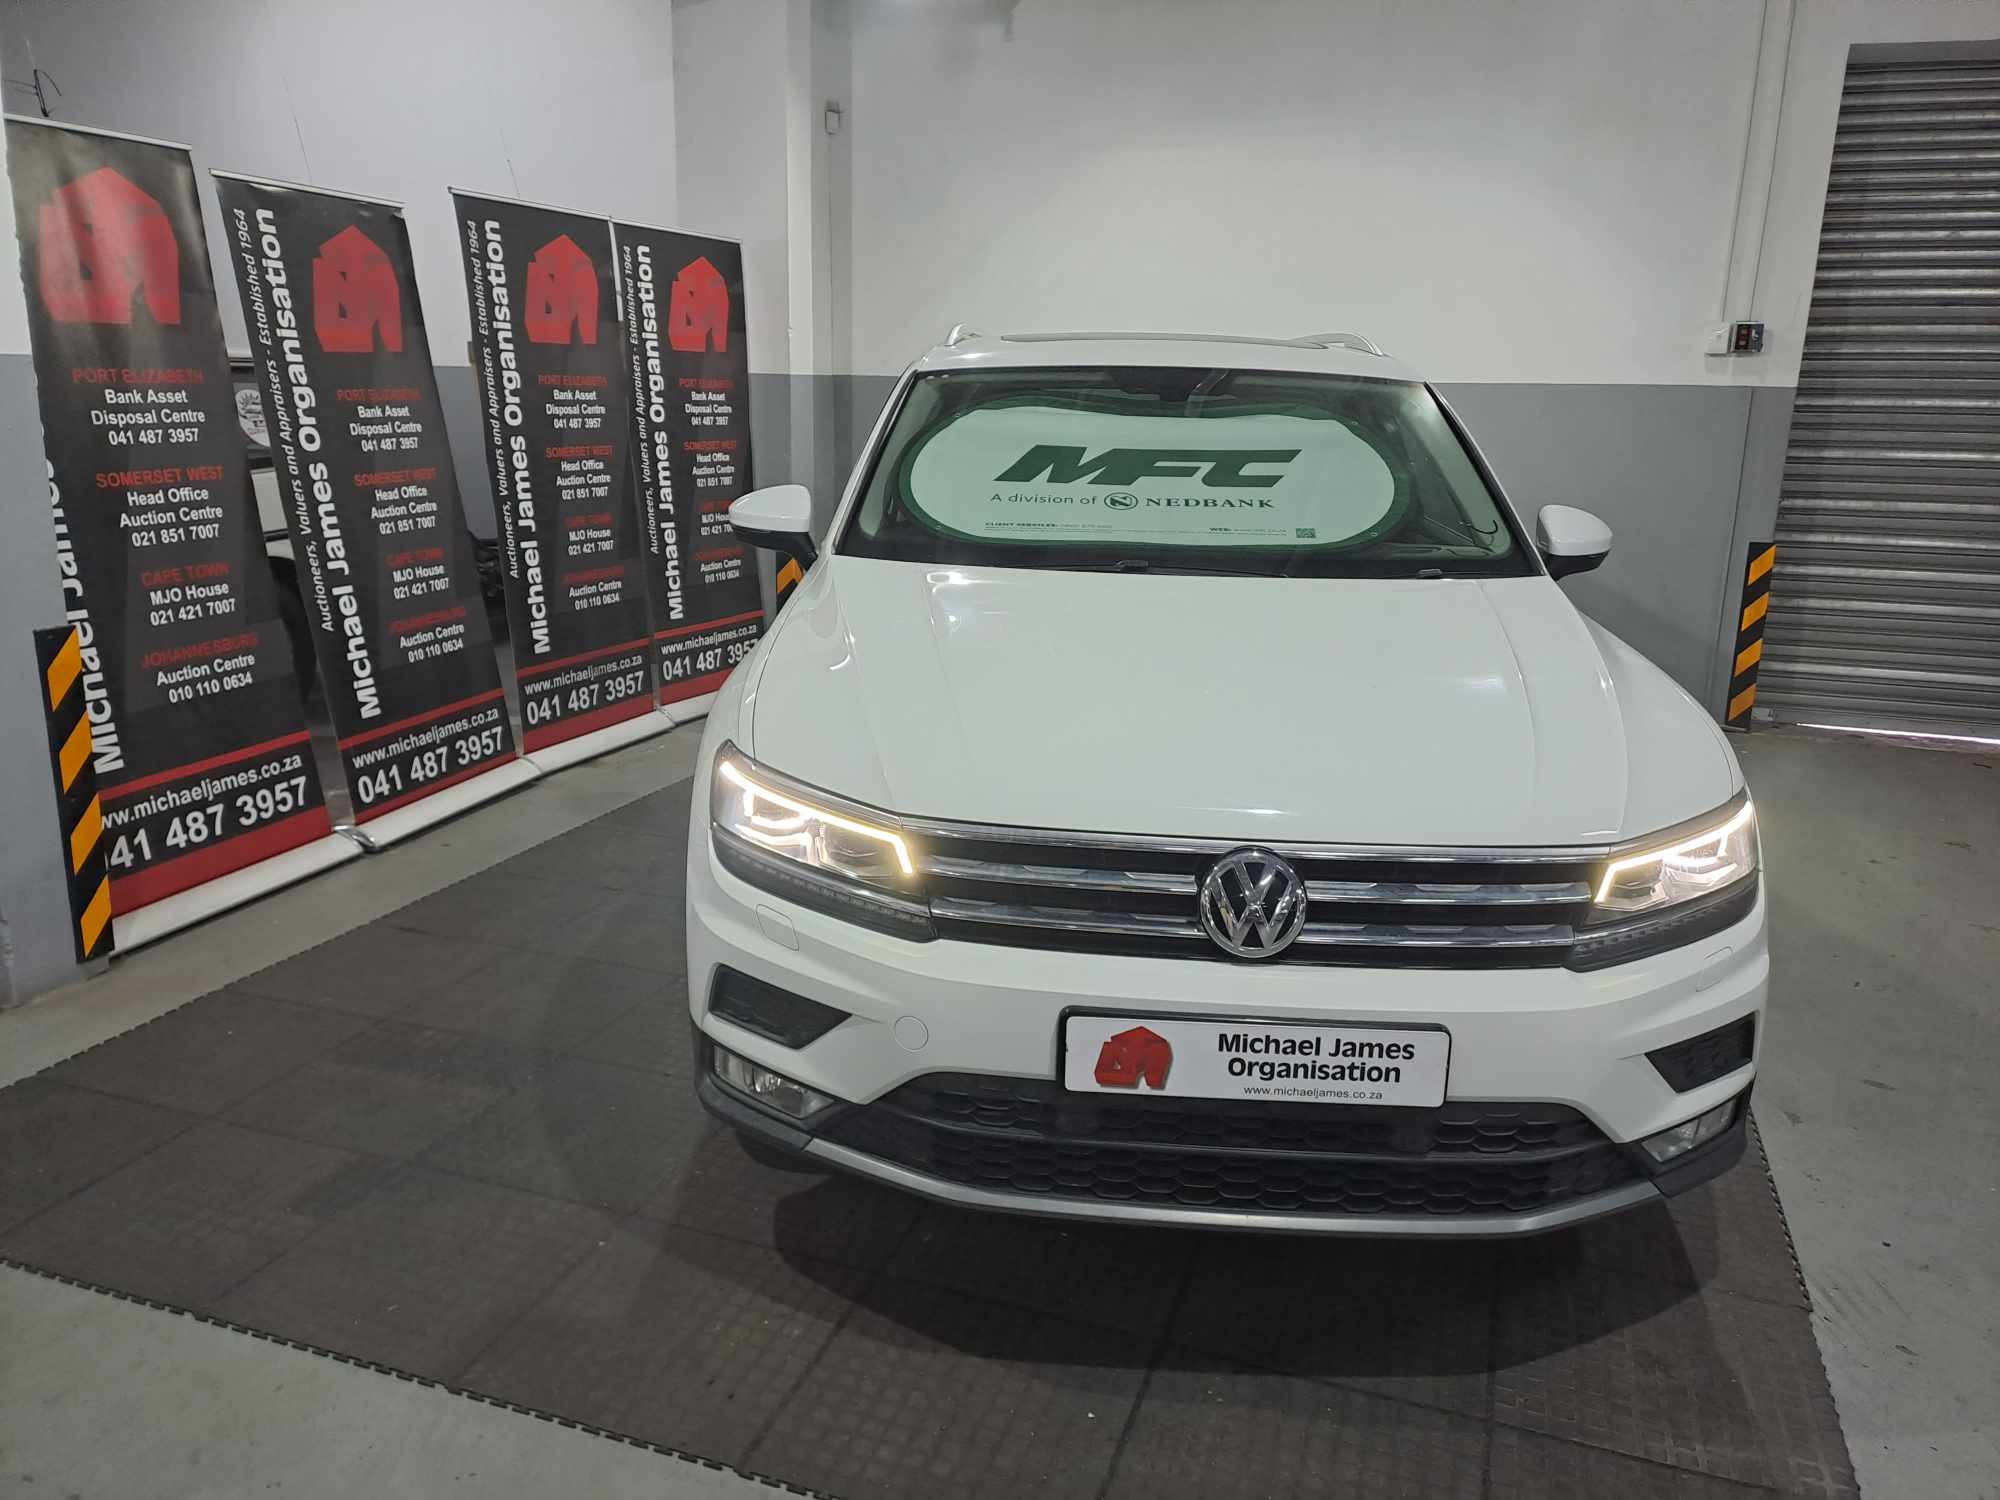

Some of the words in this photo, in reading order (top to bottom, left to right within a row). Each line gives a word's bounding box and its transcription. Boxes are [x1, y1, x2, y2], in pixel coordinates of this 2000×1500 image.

[233, 207, 252, 249] 1964
[467, 220, 480, 254] 1964
[241, 252, 272, 346] Established
[470, 256, 489, 335] Established
[255, 208, 321, 452] Organisation
[484, 219, 523, 427] Organisation
[637, 245, 665, 423] Organisation
[482, 346, 501, 417] Appraisers
[553, 389, 573, 400] Bank
[575, 389, 597, 401] Asset
[632, 354, 646, 415] Appraisers
[104, 388, 144, 404] Bank
[146, 388, 189, 404] Asset
[266, 359, 293, 442] Appraisers
[545, 403, 580, 416] Disposal
[581, 404, 606, 415] Centre
[90, 409, 158, 427] Disposal
[160, 408, 206, 423] Centre
[357, 405, 383, 418] Bank
[384, 404, 410, 417] Asset
[553, 418, 567, 429] 041
[108, 429, 134, 446] 041
[138, 429, 163, 444] 487
[167, 427, 199, 443] 3957
[349, 421, 393, 437] Disposal
[394, 421, 422, 433] Centre
[490, 419, 502, 445] and
[635, 416, 648, 439] and
[361, 439, 378, 452] 041
[380, 438, 397, 451] 487
[399, 436, 418, 450] 3957
[281, 444, 299, 475] and
[495, 448, 509, 496] Valuers
[560, 461, 580, 472] Head
[581, 459, 604, 471] Office
[640, 441, 651, 483] Valuers
[654, 430, 674, 515] James
[992, 444, 1303, 488] MFC
[96, 467, 181, 488] SOMERSET
[186, 465, 224, 481] WEST
[510, 435, 536, 533] James
[556, 475, 586, 487] Auction
[586, 473, 611, 484] Centre
[127, 489, 165, 507] Head
[167, 486, 209, 503] Office
[291, 478, 312, 535] Valuers
[374, 487, 400, 502] Head
[400, 485, 428, 499] Office
[561, 488, 575, 500] 021
[576, 487, 590, 499] 851
[990, 493, 1002, 502] A
[1008, 493, 1074, 505] division
[1079, 495, 1098, 505] of
[1145, 497, 1275, 509] NEDBANK
[119, 509, 176, 528] Auction
[178, 504, 224, 522] Centre
[308, 462, 350, 576] James
[370, 504, 408, 519] Auction
[408, 501, 438, 514] Centre
[131, 531, 157, 547] 021
[160, 527, 186, 544] 851
[188, 523, 220, 540] 7007
[379, 521, 396, 535] 021
[397, 518, 415, 533] 851
[415, 515, 436, 529] 7007
[568, 529, 586, 541] MJO
[586, 528, 611, 540] House
[502, 500, 519, 579] Auctioneers,
[392, 567, 414, 583] MJO
[415, 564, 445, 579] House
[660, 521, 684, 620] Michael
[150, 587, 182, 606] MJO
[185, 583, 229, 600] House
[305, 540, 335, 632] Auctioneers,
[393, 585, 410, 600] 021
[411, 581, 428, 596] 421
[429, 576, 450, 592] 7007
[520, 540, 551, 654] Michael
[569, 584, 597, 598] Auction
[150, 608, 175, 626] 021
[178, 603, 203, 621] 421
[206, 598, 236, 616] 7007
[574, 598, 588, 611] 010
[588, 595, 601, 608] 110
[400, 631, 435, 649] Auction
[435, 623, 465, 640] Centre
[407, 647, 425, 663] 010
[425, 643, 441, 658] 110
[441, 637, 464, 654] 0634
[661, 624, 757, 655] www.michaeljames.co.za
[331, 584, 382, 720] Michael
[662, 655, 692, 681] 041
[696, 647, 722, 672] 487
[156, 664, 210, 687] Auction
[213, 653, 255, 673] Centre
[524, 655, 643, 695] www.michaeljames.co.za
[168, 685, 193, 703] 010
[195, 678, 220, 697] 110
[223, 670, 253, 691] 0634
[526, 693, 561, 725] 041
[567, 683, 600, 712] 487
[605, 670, 644, 702] 3957
[352, 707, 499, 769] www.michaeljames.co.za
[357, 763, 403, 804] 041
[410, 745, 448, 782] 487
[455, 725, 503, 765] 3957
[104, 828, 152, 871] 41
[166, 803, 225, 849] 487
[235, 775, 307, 827] 3957
[1218, 1033, 1321, 1057] Michael
[1328, 1038, 1415, 1061] James
[1228, 1057, 1401, 1083] Organisation
[1244, 1086, 1383, 1100] www.michaeljames.co.za
